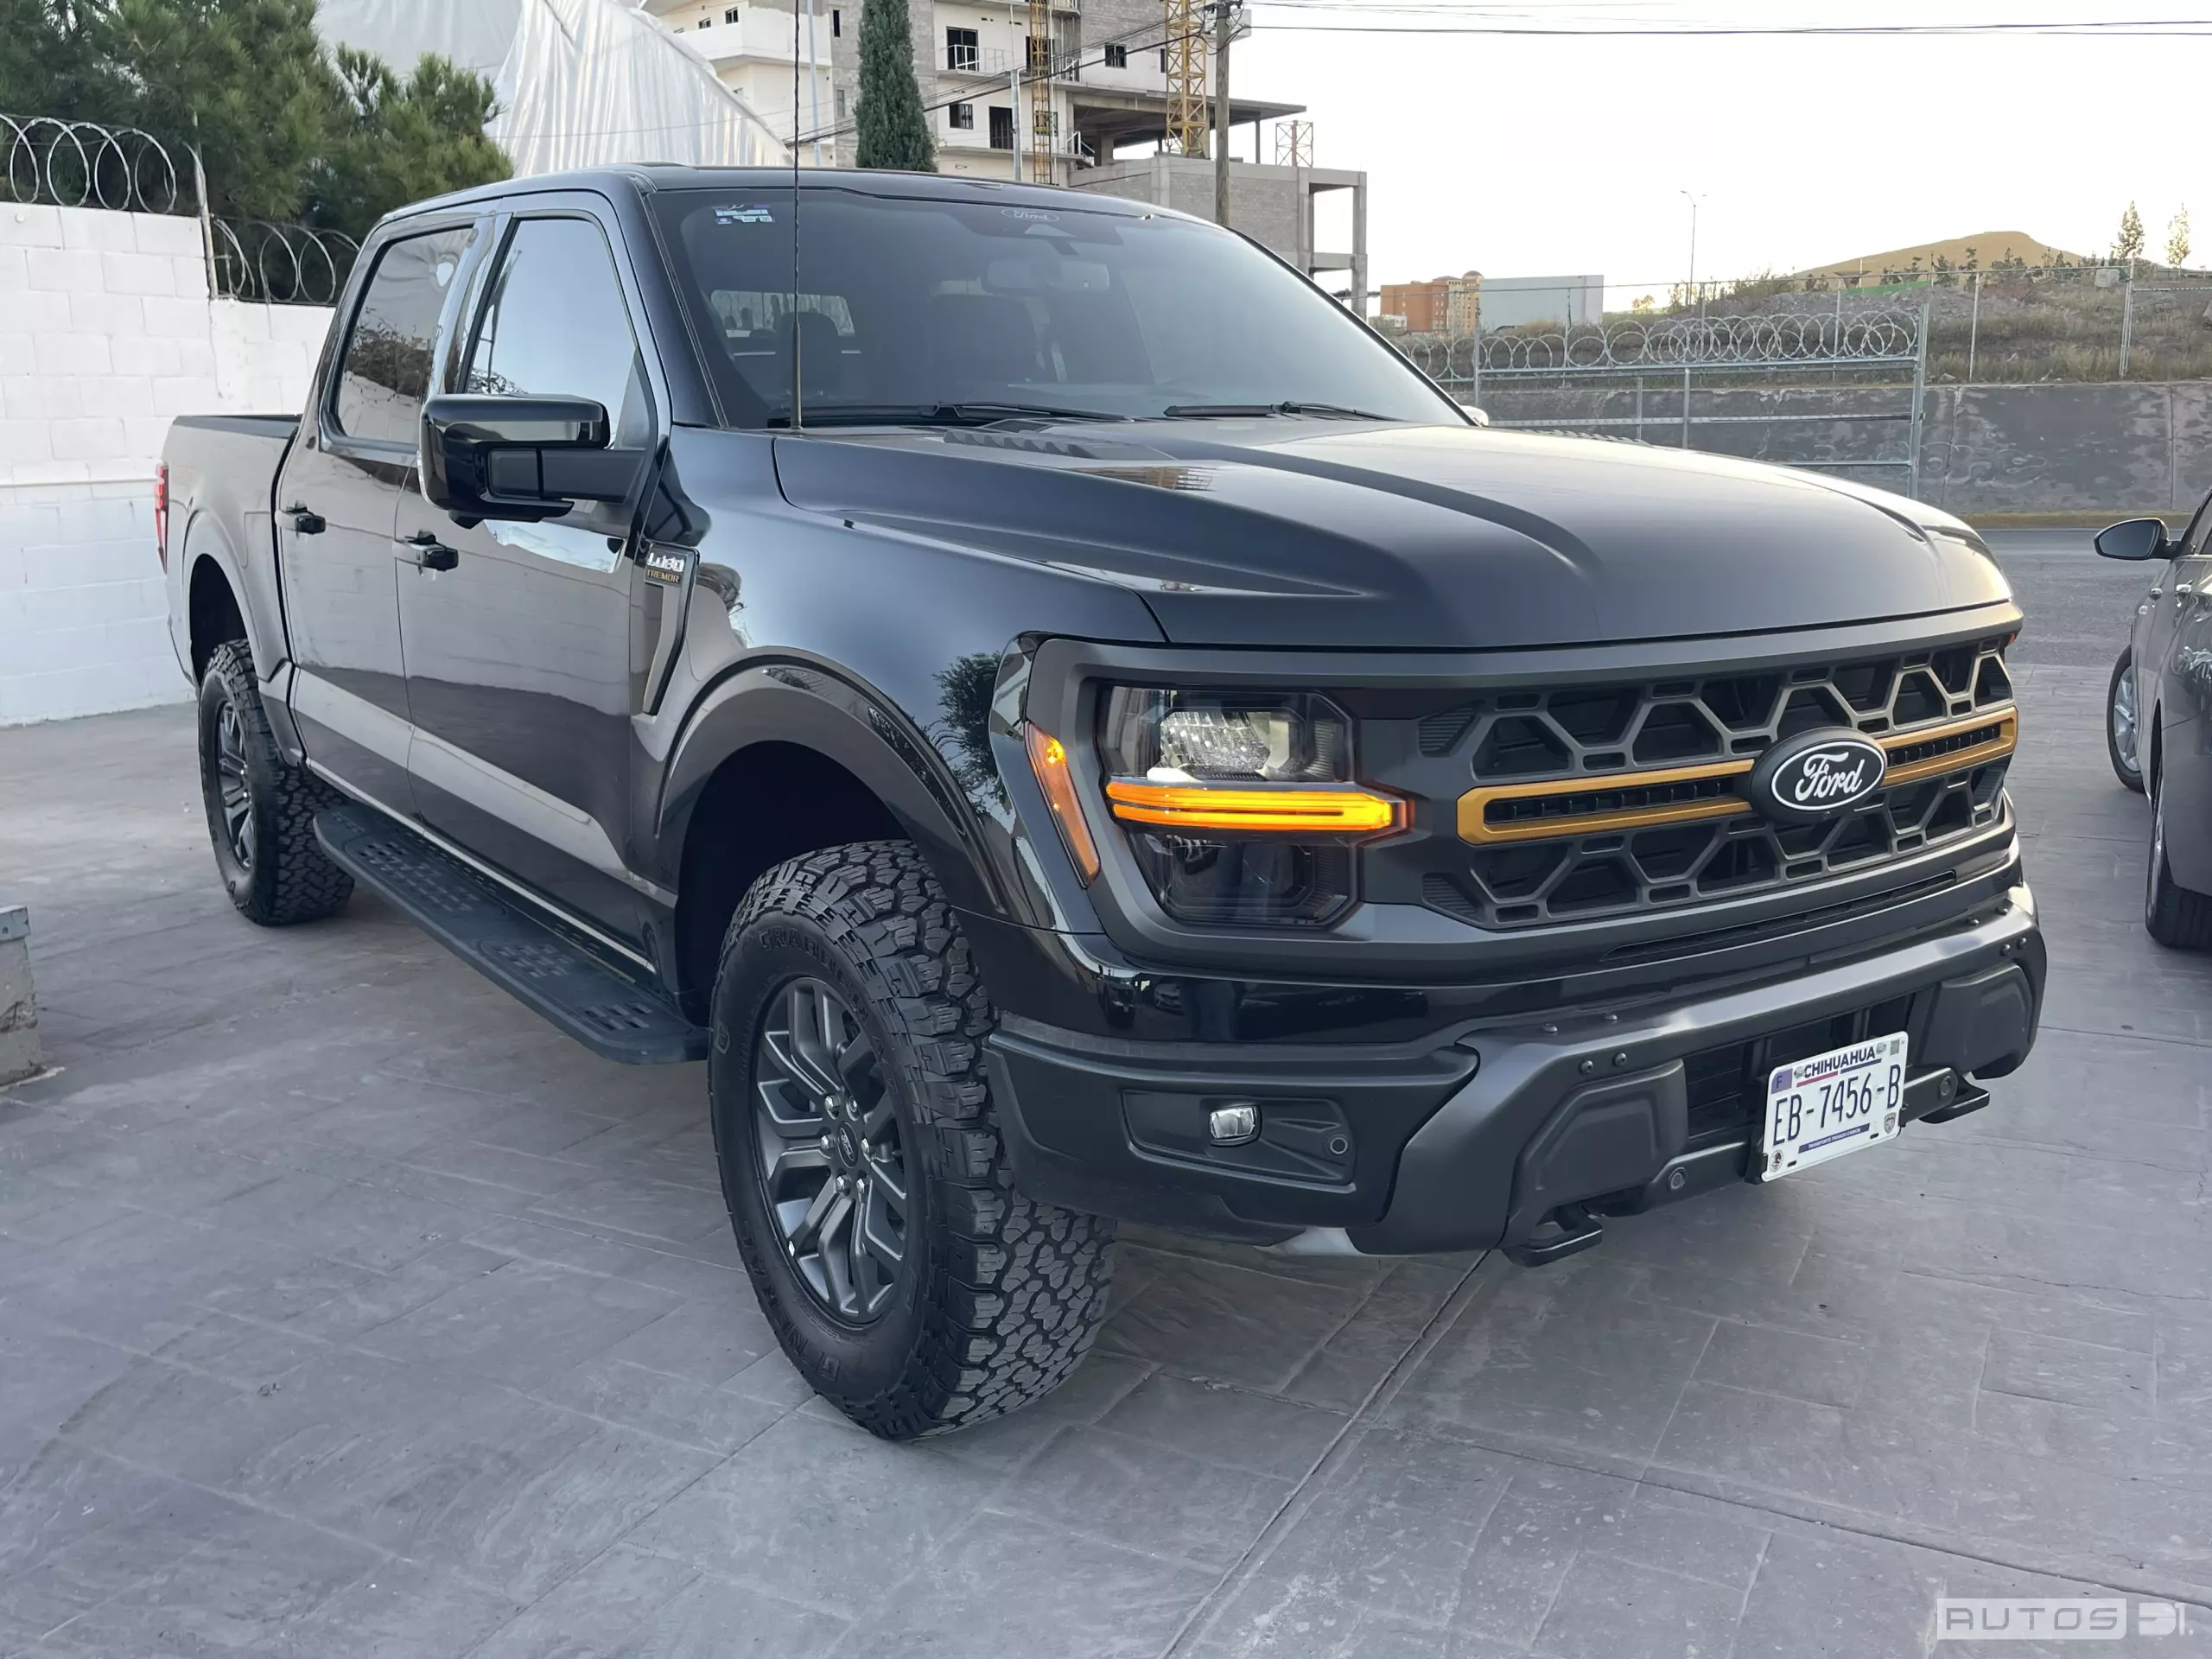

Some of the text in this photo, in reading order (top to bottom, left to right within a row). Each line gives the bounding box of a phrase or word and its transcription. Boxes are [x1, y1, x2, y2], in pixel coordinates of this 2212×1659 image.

[646, 569, 680, 583] TREMOR
[1795, 751, 1866, 802] Ford
[1803, 1045, 1876, 1079] CHIHUAHUA
[1773, 1064, 1901, 1147] EB-7456-B
